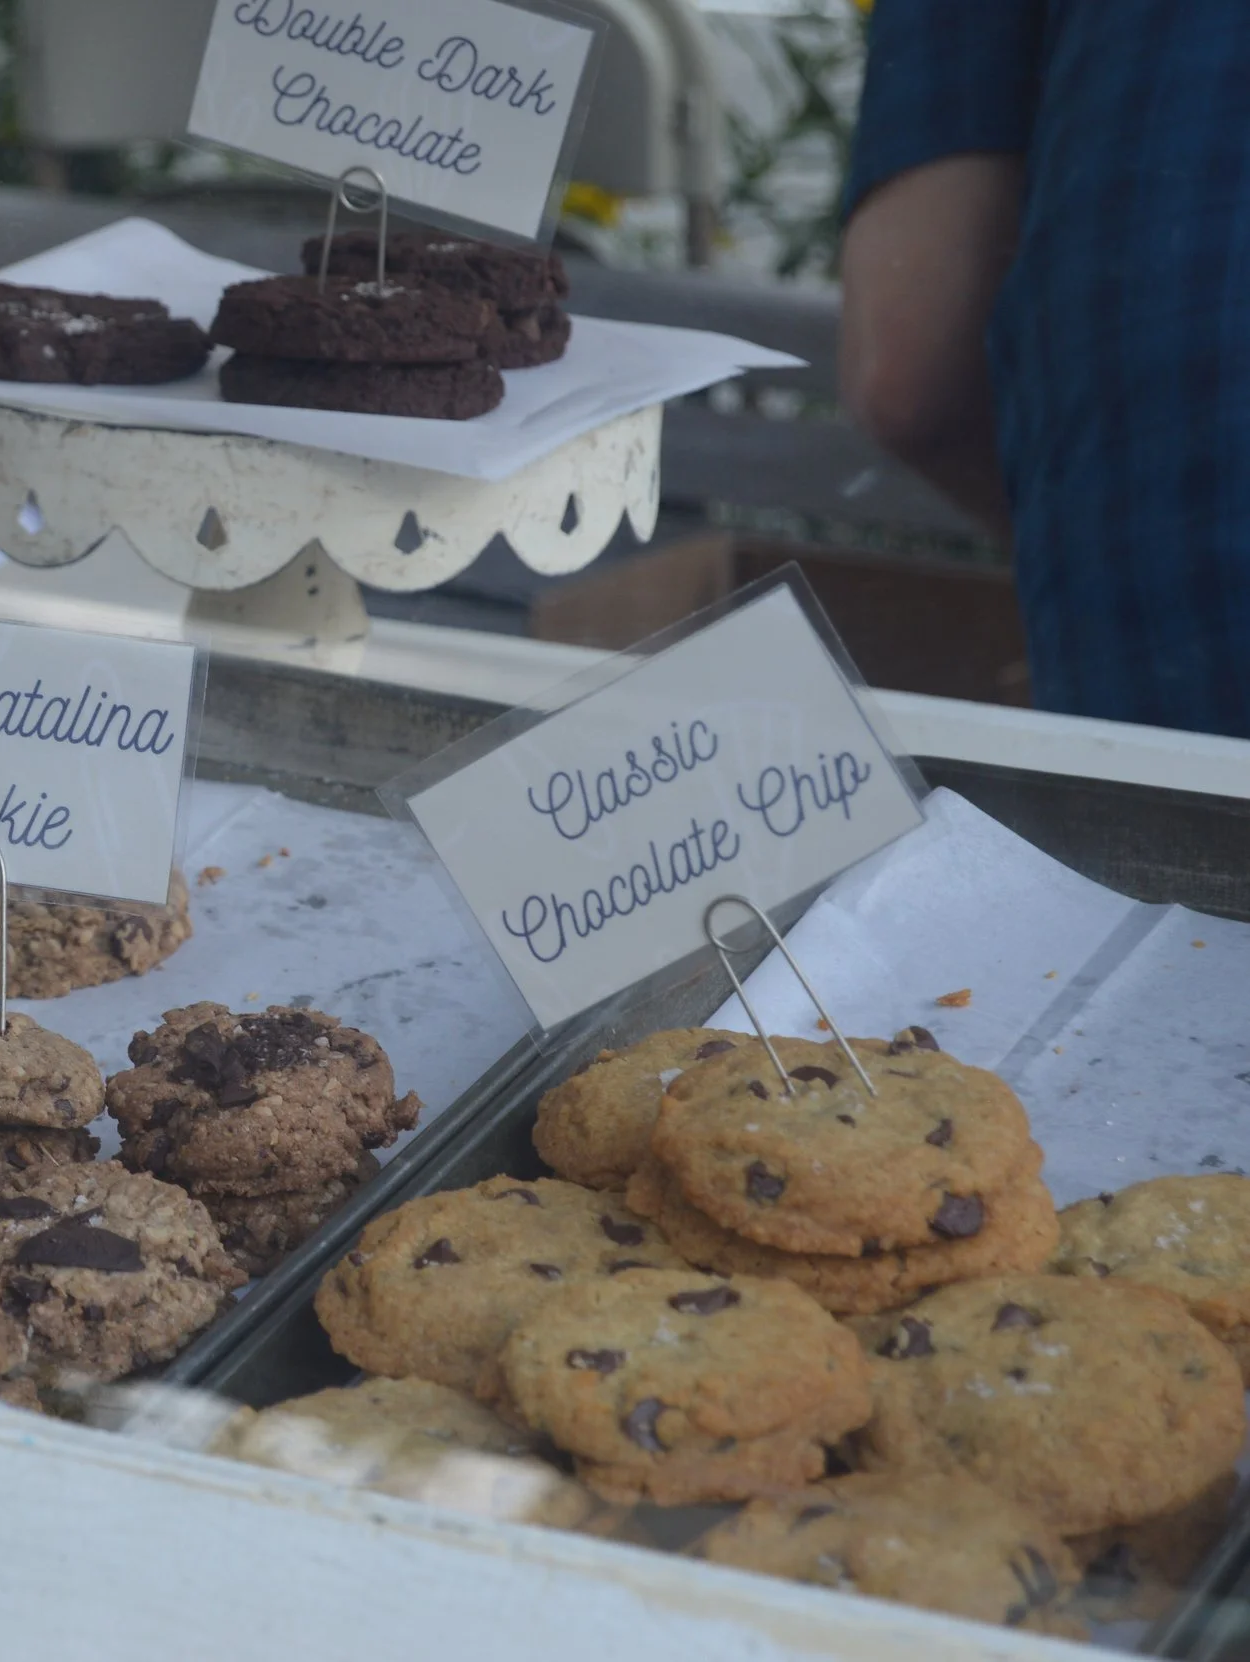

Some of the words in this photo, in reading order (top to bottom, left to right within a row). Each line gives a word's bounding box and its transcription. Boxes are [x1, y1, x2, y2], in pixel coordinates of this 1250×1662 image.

[235, 0, 405, 69] Double
[418, 36, 556, 116] Dark
[272, 65, 482, 175] Chocolate
[527, 720, 718, 839] Classic
[502, 818, 740, 962] Chocolate
[737, 750, 871, 836] Chip
